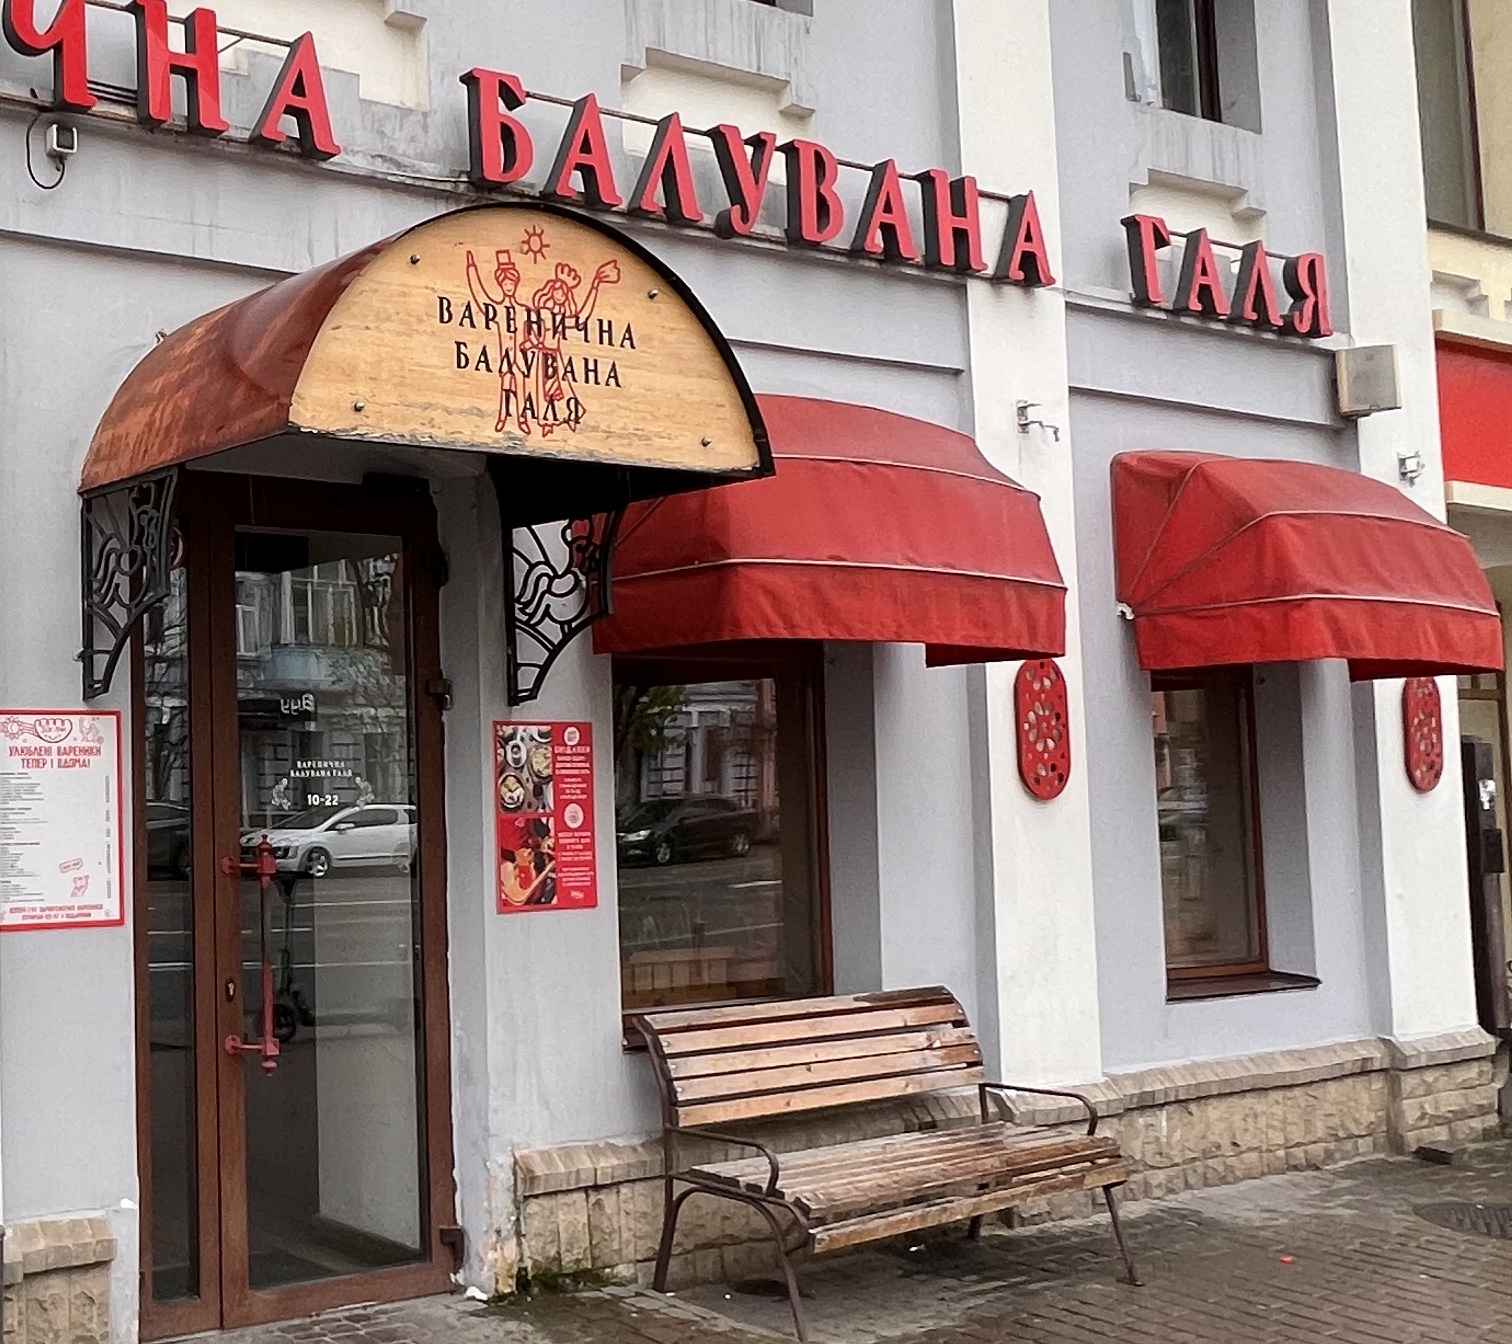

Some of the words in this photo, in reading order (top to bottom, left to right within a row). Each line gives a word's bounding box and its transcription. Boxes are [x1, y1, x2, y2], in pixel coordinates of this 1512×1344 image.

[460, 67, 1055, 288] БАЛУВАНА
[1121, 214, 1333, 338] ГАЛЯ
[437, 297, 636, 350] ВАРЕНИЧНА
[456, 341, 621, 388] БАЛУВАНА
[503, 388, 584, 424] ГАЛЯ
[21, 758, 47, 769] ТЕПЕР
[307, 794, 338, 806] 10-22
